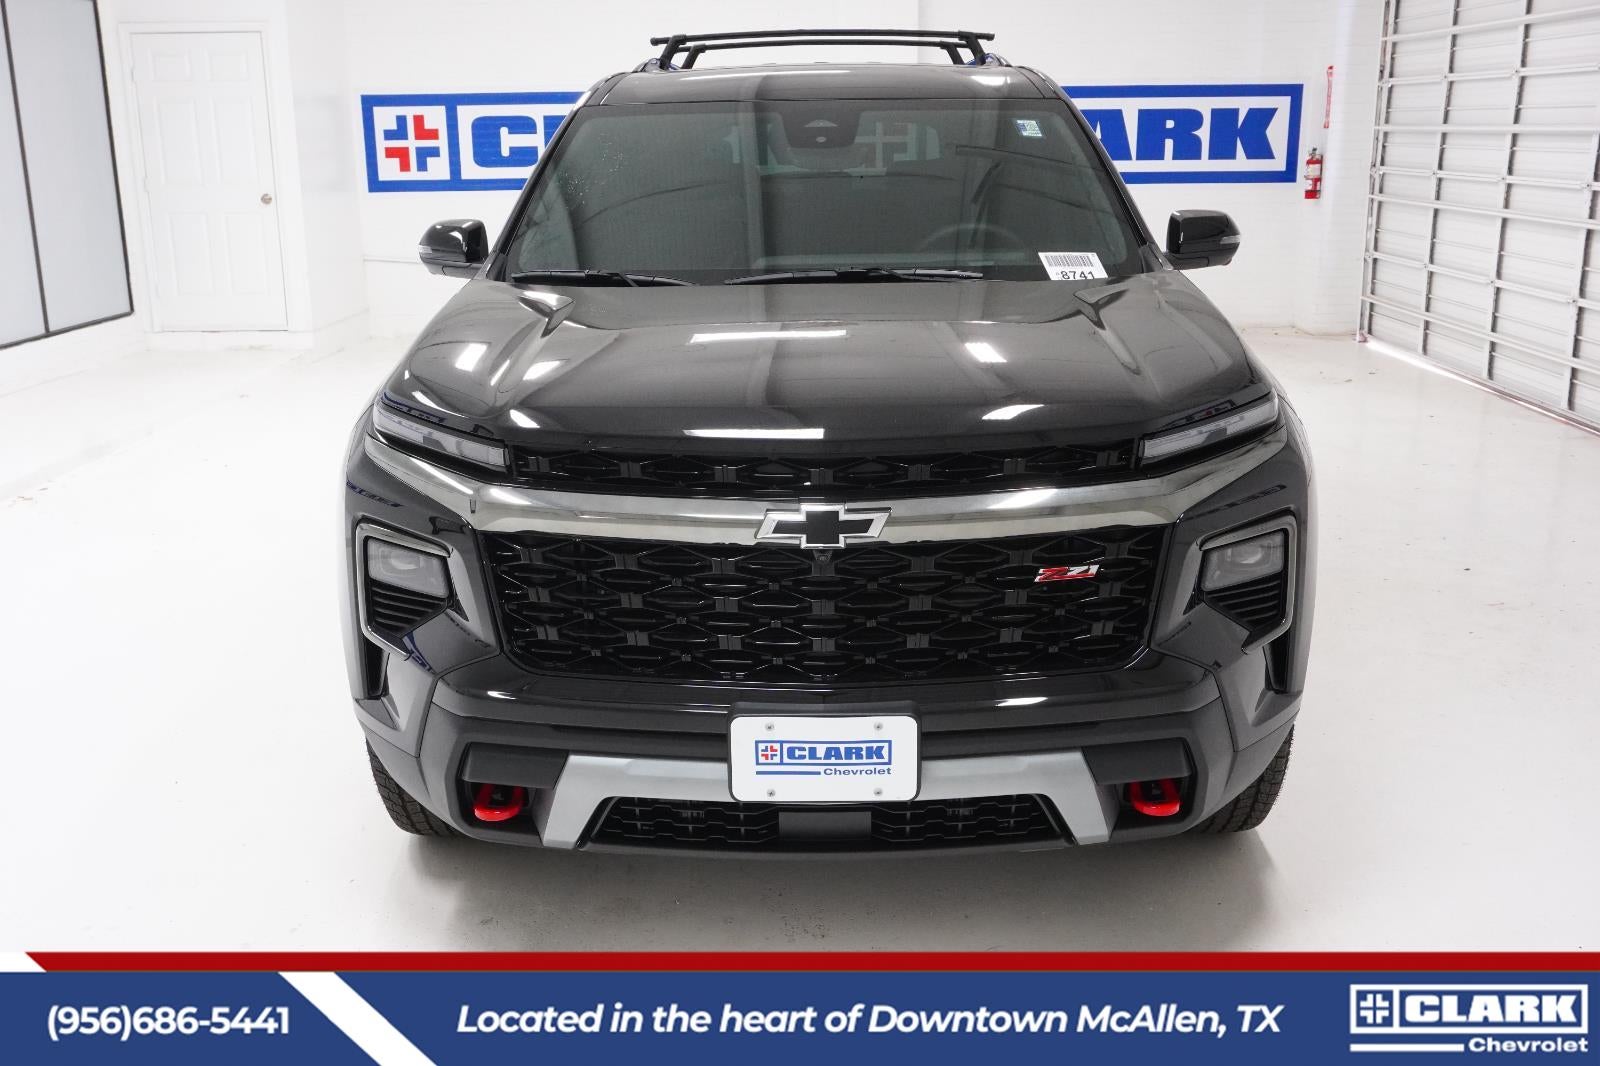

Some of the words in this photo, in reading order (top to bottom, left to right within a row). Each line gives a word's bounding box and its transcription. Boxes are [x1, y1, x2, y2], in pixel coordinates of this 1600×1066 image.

[1060, 270, 1095, 280] 8741
[1034, 564, 1100, 582] Z71
[786, 745, 886, 761] CLARK
[823, 767, 892, 776] Chevrolet
